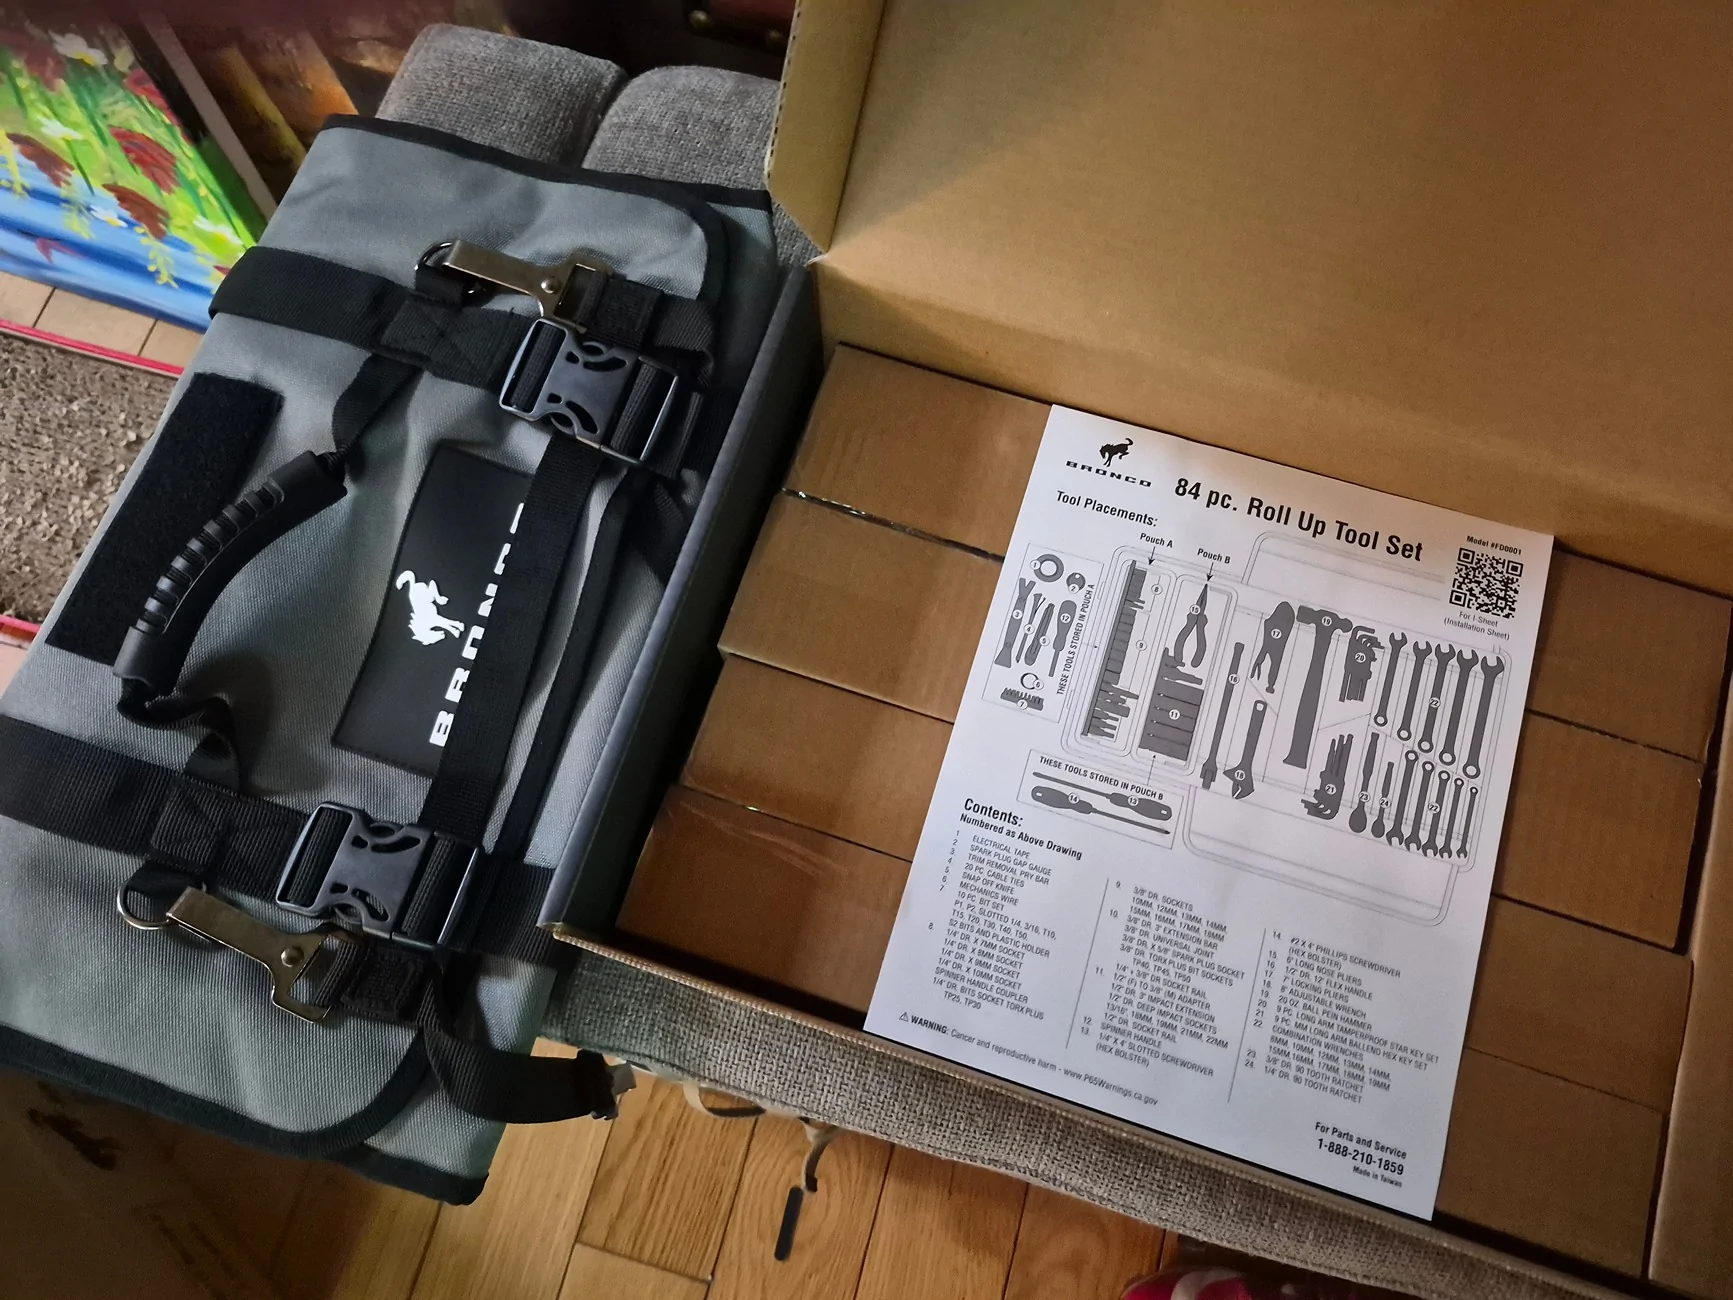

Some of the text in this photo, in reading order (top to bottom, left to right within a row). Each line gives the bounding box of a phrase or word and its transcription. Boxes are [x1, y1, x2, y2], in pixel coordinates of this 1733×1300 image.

[1065, 460, 1151, 487] BRONCO
[1057, 490, 1158, 527] Tool Placements:
[1174, 477, 1423, 561] 84 pc. Roll Up Tool Set
[1139, 532, 1172, 548] Pouch A
[1466, 535, 1489, 547] Model
[1196, 547, 1231, 564] Pouch B
[1080, 590, 1093, 613] POUCH
[1458, 610, 1471, 620] For
[1078, 613, 1086, 622] IN
[1443, 617, 1510, 641] (Installation Sheet)
[1070, 622, 1083, 649] STORED
[1063, 650, 1075, 672] TOOLS
[1057, 673, 1069, 695] THESE
[1039, 755, 1163, 800] THESE TOOLS STORED IN POUCH B
[963, 797, 1023, 827] Contents:
[959, 812, 1082, 860] Numbered as Above Drawing
[972, 834, 1030, 859] ELECTRICAL TAPE
[967, 852, 1049, 885] TRIM REMOVAL PRY BAR
[969, 843, 1052, 876] SPARK PLUG GAP GAUGE
[961, 871, 1015, 895] SNAP OFF KNIFE
[986, 869, 1025, 888] CABLE TIES
[959, 880, 1019, 906] MECHANICS WIRE
[978, 897, 1005, 911] BIT SET
[1161, 895, 1193, 912] SOCKETS
[948, 918, 1050, 958] S2 BITS AND PLASTIC HOLDER
[1152, 933, 1214, 959] UNIVERSAL JOINT
[1162, 926, 1218, 950] EXTENSION BAR
[1171, 949, 1245, 979] SPARK PLUG SOCKET
[1288, 946, 1342, 971] (HEX BOLSTER)
[1315, 944, 1401, 978] PHILLIPS SCREWDRIVER
[934, 966, 1028, 1004] SPINNER HANDLE COUPLER
[1294, 958, 1362, 987] LONG NOSE PLIERS
[1177, 994, 1210, 1011] ADAPTER
[1290, 977, 1349, 1003] LOCKING PLIERS
[1325, 978, 1372, 1000] FLEX HANDLE
[1147, 994, 1215, 1023] IMPACT EXTENSION
[1288, 987, 1366, 1019] ADJUSTABLE WRENCH
[1301, 1002, 1372, 1031] BALL PEIN HAMMER
[1136, 1001, 1217, 1035] DEEP IMPACT SOCKETS
[910, 1014, 948, 1035] WARNING:
[950, 1028, 976, 1043] Cancer
[975, 1038, 991, 1049] and
[991, 1043, 1036, 1065] reproductive
[1036, 1058, 1057, 1071] harm
[1100, 1021, 1162, 1049] SPINNER HANDLE
[1271, 1024, 1363, 1061] COMBINATION WRENCHES
[1295, 1011, 1439, 1063] LONG ARM TAMPERPROOF STAR KEY SET
[1308, 1026, 1427, 1070] LONG ARM BALLEND HEX KEY SET
[1095, 1042, 1150, 1068] (HEX BOLSTER)
[1127, 1041, 1214, 1077] SLOTTED SCREWDRIVER
[1306, 1067, 1363, 1093] TOOTH RATCHET
[1314, 1121, 1407, 1159] For Parts and Service
[1318, 1137, 1404, 1175] 1-888-210-1859
[1352, 1165, 1402, 1187] Made in Taiwan
